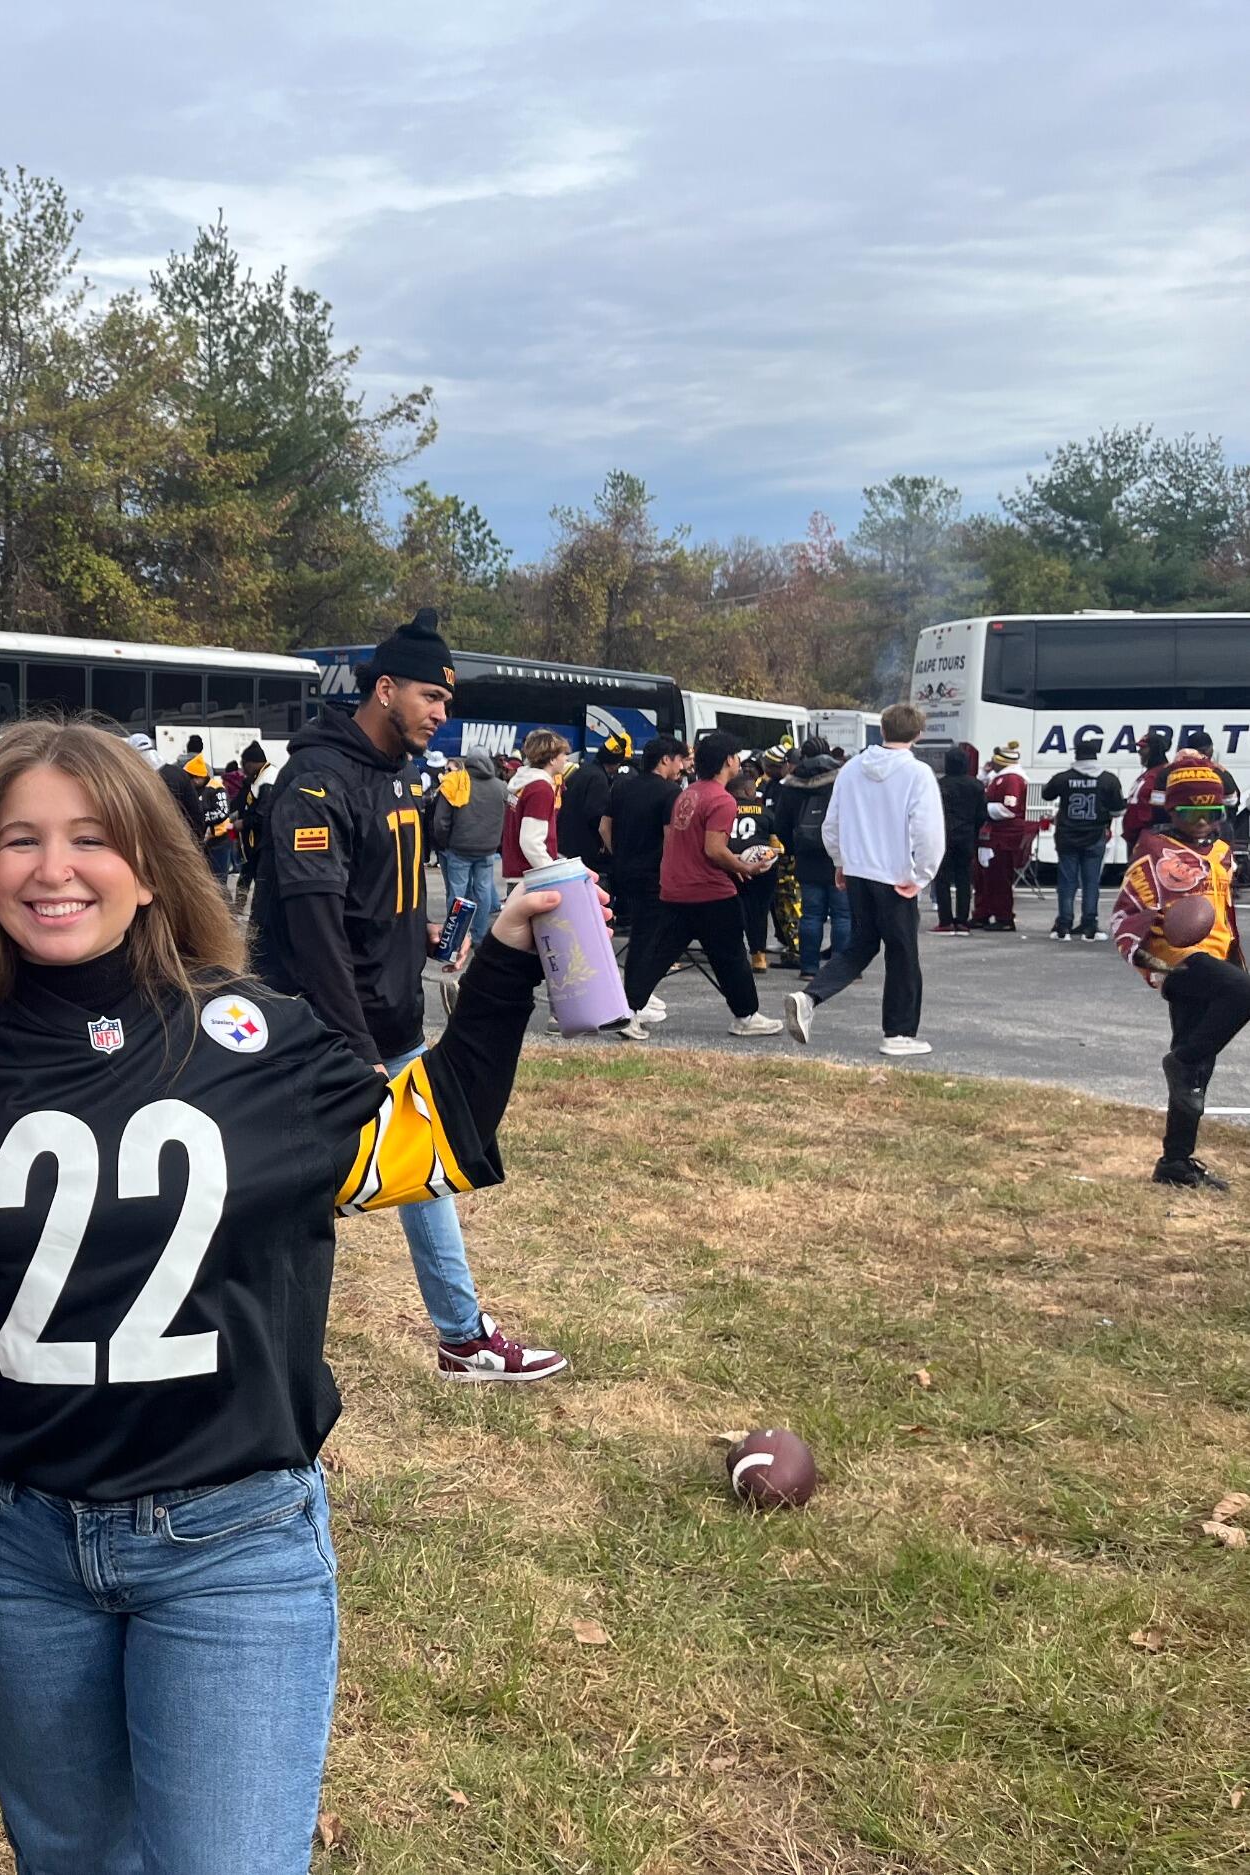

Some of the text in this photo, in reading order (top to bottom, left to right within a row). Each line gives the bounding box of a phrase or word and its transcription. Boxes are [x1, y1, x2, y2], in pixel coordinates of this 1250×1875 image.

[938, 655, 966, 672] TOURS
[460, 722, 517, 757] WINN
[1068, 778, 1098, 789] TAYLOR
[1067, 793, 1098, 820] 21
[730, 816, 756, 840] 19
[386, 808, 423, 915] 17
[439, 915, 457, 950] ULTRA
[210, 1018, 234, 1026] Steelers
[95, 1032, 120, 1047] NFL
